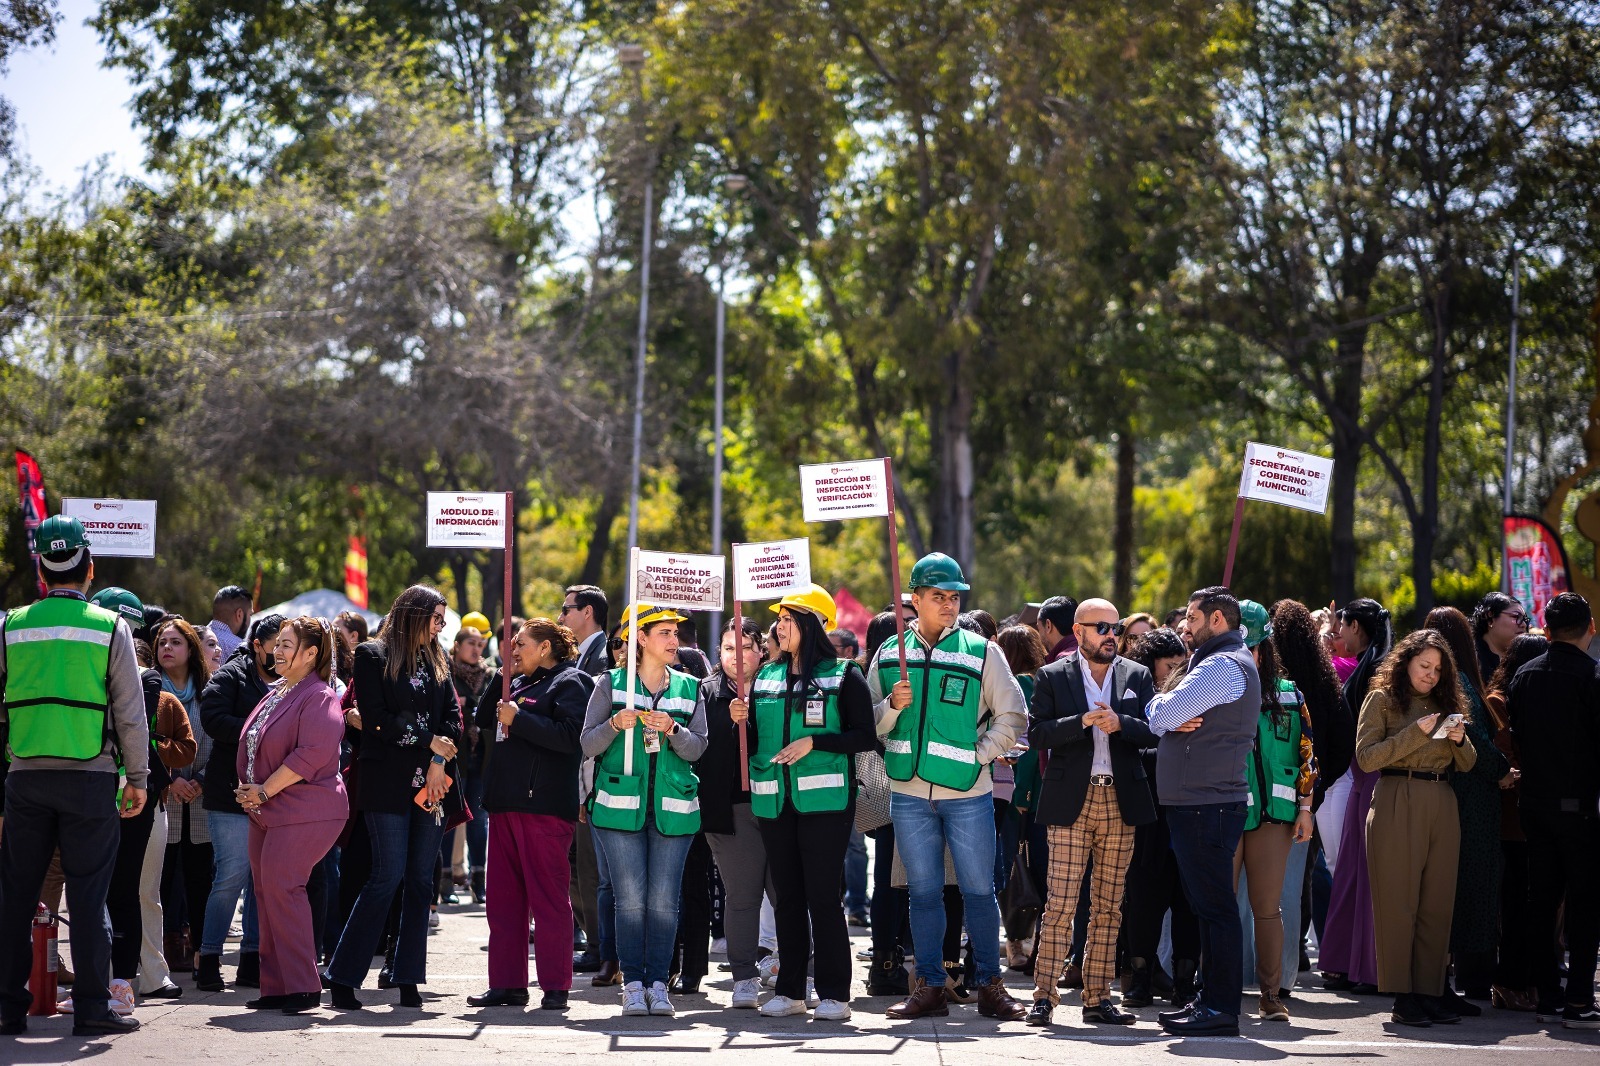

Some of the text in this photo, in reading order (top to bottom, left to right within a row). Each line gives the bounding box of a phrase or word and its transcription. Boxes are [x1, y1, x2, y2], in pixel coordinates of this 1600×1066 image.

[1250, 458, 1320, 478] SECRETARÍA DE
[815, 476, 858, 486] DIRECCIÓN
[1260, 470, 1307, 486] GOBIERNO
[816, 484, 864, 494] INSPECCIÓN
[1256, 480, 1306, 496] MUNICIPAL
[816, 492, 872, 502] VERIFICACIÓN
[436, 517, 498, 526] INFORMACIÓN
[52, 542, 64, 550] 38
[754, 554, 790, 564] DIRECCIÓN
[646, 566, 696, 576] DIRECCIÓN
[748, 564, 785, 573] MUNICIPAL
[654, 575, 702, 584] ATENCIÓN
[751, 572, 785, 581] ATENCIÓN
[757, 580, 791, 589] MIGRANTE
[653, 592, 703, 601] INDIGENAS
